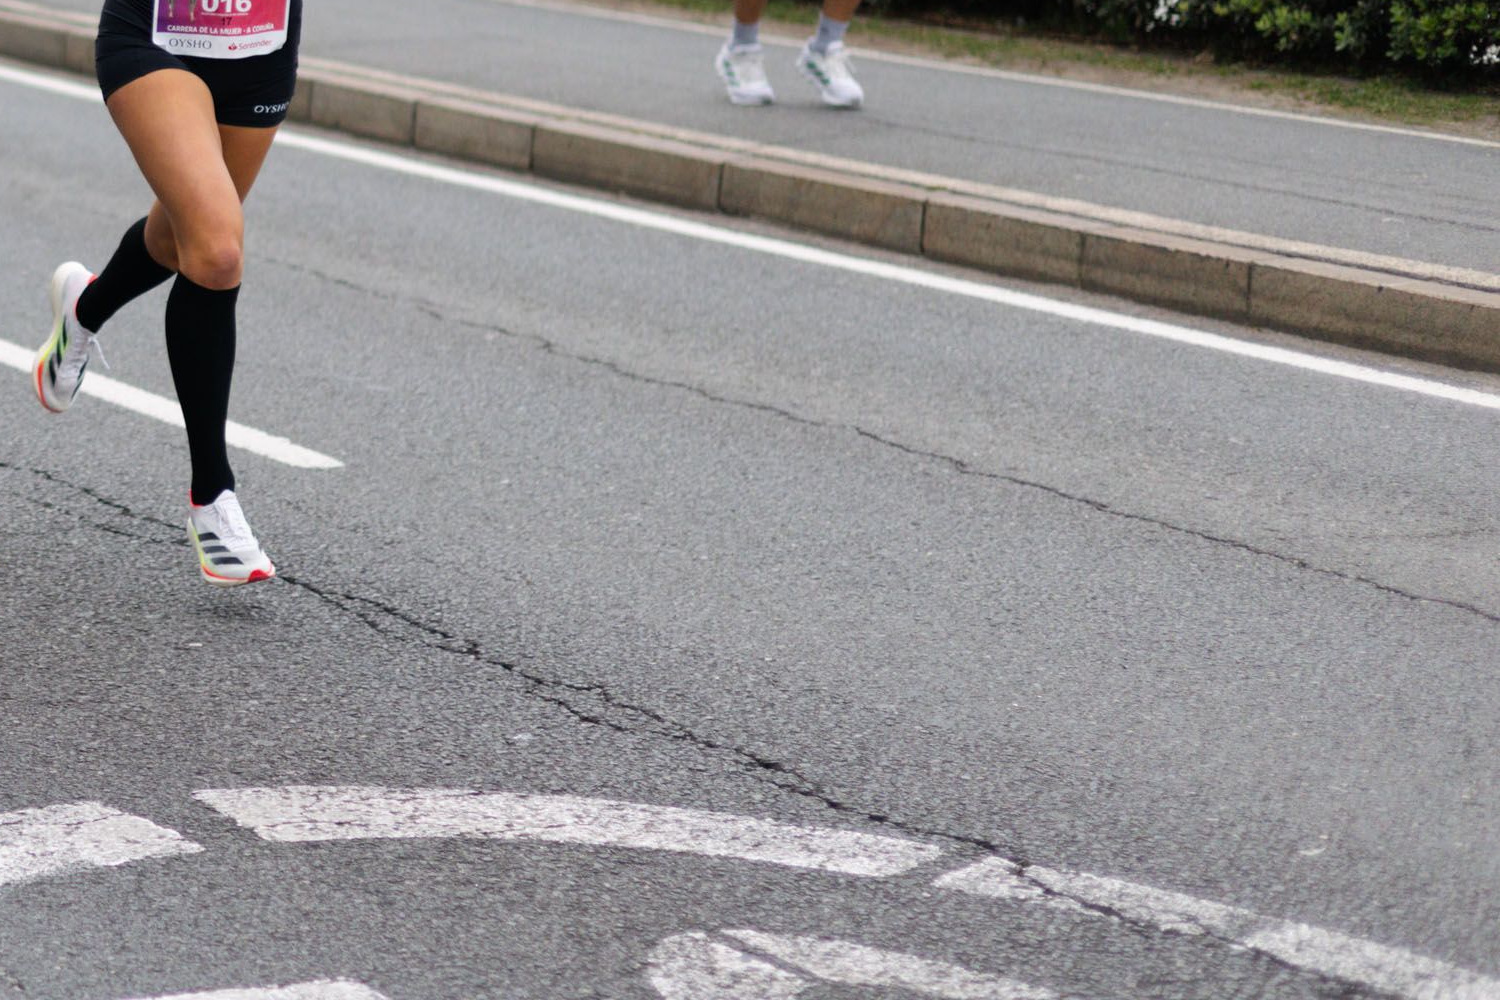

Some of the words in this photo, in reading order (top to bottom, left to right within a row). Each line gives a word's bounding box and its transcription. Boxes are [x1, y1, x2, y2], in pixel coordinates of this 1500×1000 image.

[221, 16, 232, 26] 17
[167, 24, 197, 32] CARRERA
[198, 25, 208, 33] DE
[209, 26, 218, 34] LA
[220, 26, 242, 35] MUJER
[169, 37, 212, 49] OYSHO
[237, 39, 273, 51] Santander
